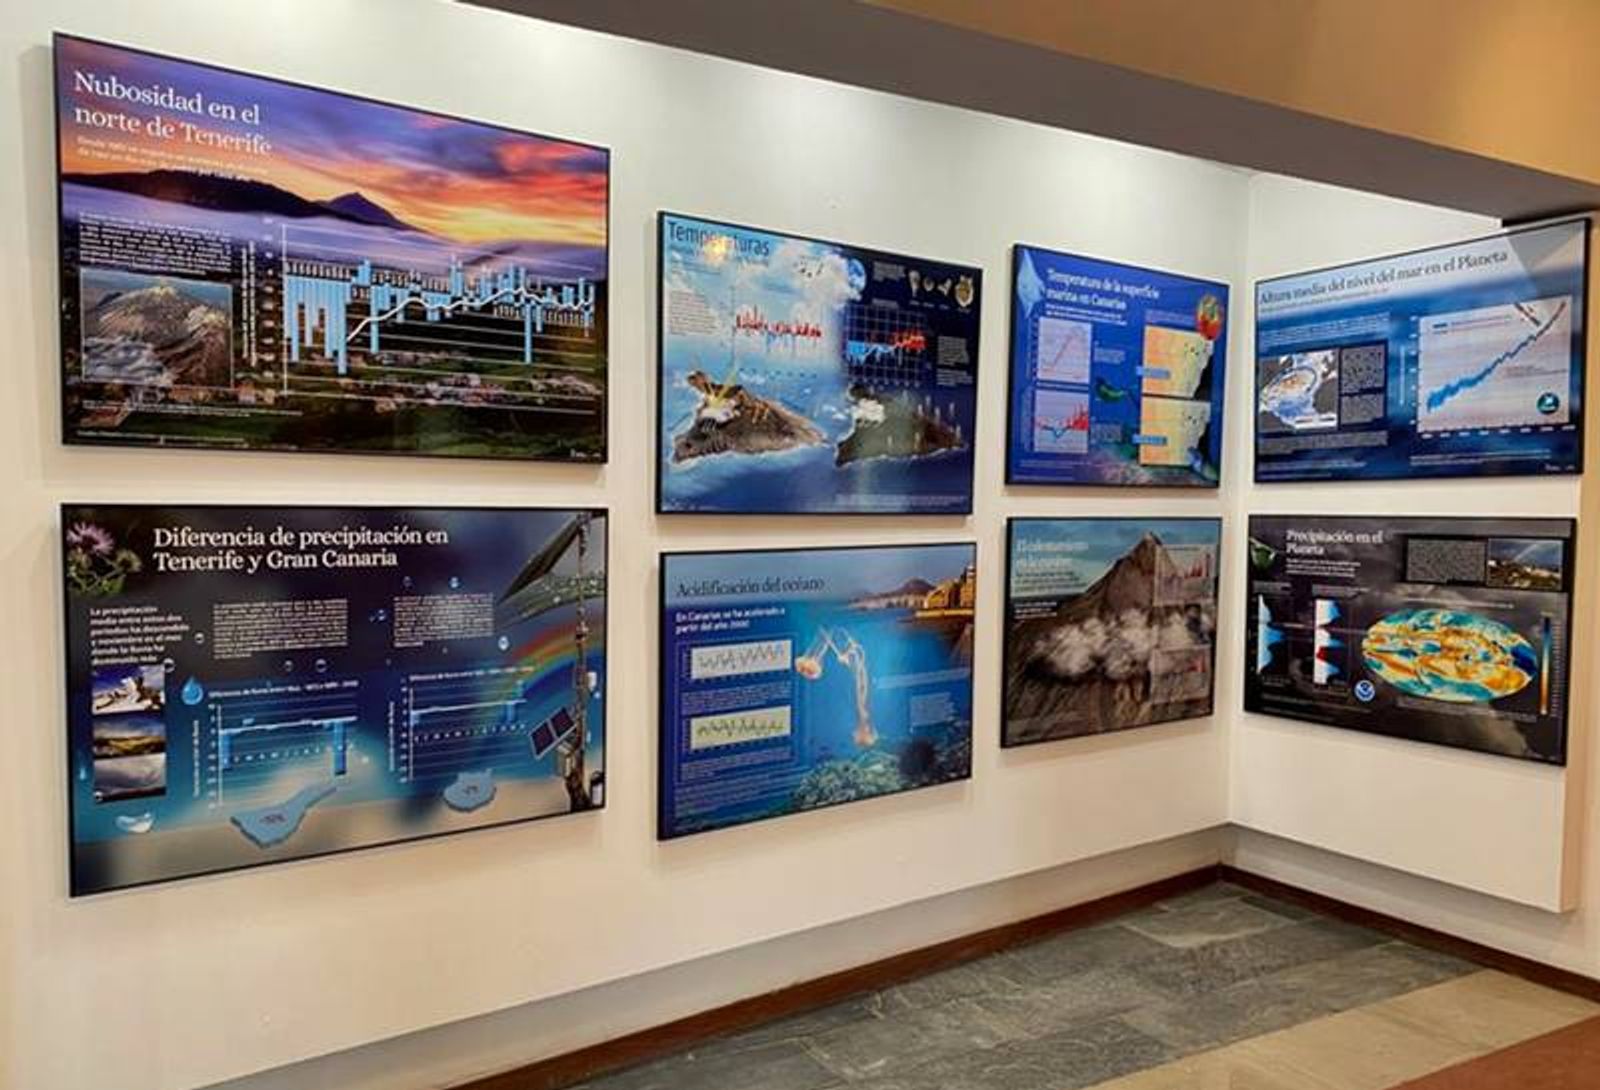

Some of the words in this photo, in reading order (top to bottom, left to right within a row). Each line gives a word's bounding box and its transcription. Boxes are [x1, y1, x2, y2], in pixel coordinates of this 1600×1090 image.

[74, 70, 202, 114] Nubosidad
[208, 103, 236, 121] en
[242, 104, 260, 125] el
[74, 108, 141, 133] norte
[146, 118, 175, 139] de
[180, 121, 272, 156] Tenerife
[667, 220, 770, 256] Tempturas
[1260, 290, 1292, 305] Altura
[1293, 284, 1326, 300] media
[1328, 278, 1346, 293] del
[1347, 273, 1375, 289] nivel
[1377, 269, 1396, 284] del
[1398, 267, 1424, 279] mar
[1425, 264, 1442, 275] en
[1443, 258, 1455, 272] el
[1458, 252, 1508, 271] Planeta
[154, 527, 265, 547] Diferencia
[270, 526, 295, 545] de
[299, 525, 422, 550] precipitación
[425, 530, 448, 544] en
[1356, 533, 1371, 543] en
[1372, 530, 1384, 543] el
[153, 550, 244, 571] Tenerife
[247, 555, 262, 573] y
[266, 549, 317, 569] Gran
[322, 548, 398, 568] Canaria
[677, 579, 760, 596] Acidificación
[762, 576, 781, 592] del
